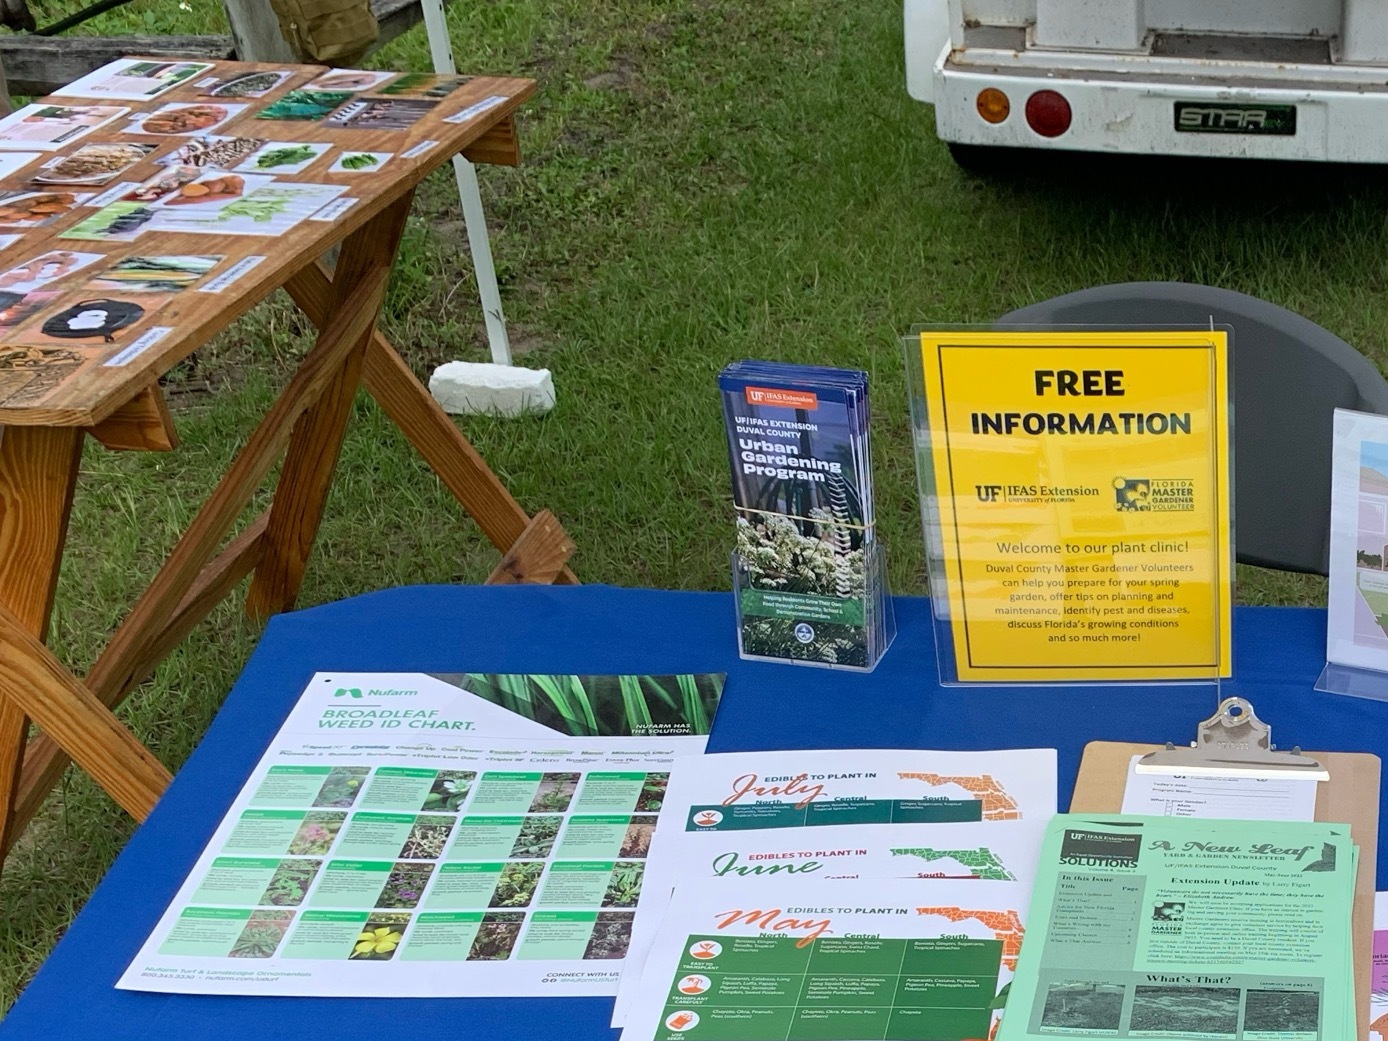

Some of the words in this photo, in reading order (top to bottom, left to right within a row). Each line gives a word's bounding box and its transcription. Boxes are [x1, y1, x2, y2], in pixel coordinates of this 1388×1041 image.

[1179, 108, 1267, 127] STAR
[1035, 370, 1125, 397] FREE
[770, 420, 818, 431] EXTENSION
[971, 413, 1191, 435] INFORMATION
[737, 426, 765, 435] DUVAL
[766, 429, 801, 439] COUNTY
[739, 438, 798, 455] Urban
[741, 451, 842, 473] Gardening
[743, 463, 825, 482] Program
[976, 486, 1002, 503] UF
[1008, 486, 1037, 496] IFAS
[1040, 486, 1099, 496] Extension
[1152, 488, 1194, 497] MASTER
[997, 542, 1062, 554] Welcome
[1066, 543, 1080, 554] to
[1084, 545, 1107, 554] our
[1112, 542, 1146, 556] plant
[1150, 542, 1189, 553] clinic!
[986, 564, 1014, 572] Duval
[1016, 564, 1052, 574] County
[1055, 564, 1089, 573] Master
[1092, 564, 1138, 573] Gardener
[1141, 563, 1193, 572] Volunteers
[1022, 578, 1044, 589] help
[1047, 580, 1064, 588] you
[1068, 580, 1106, 589] prepare
[1108, 578, 1122, 587] for
[1126, 580, 1147, 588] your
[1150, 578, 1180, 588] spring
[1010, 592, 1046, 602] garden,
[1050, 592, 1073, 600] offer
[1076, 592, 1094, 602] tips
[1112, 592, 1153, 602] planning
[1156, 592, 1173, 600] and
[995, 606, 1061, 616] maintenance,
[1064, 606, 1100, 616] identify
[1104, 607, 1124, 616] pest
[1127, 606, 1144, 614] and
[1147, 606, 1190, 615] diseases,
[1008, 620, 1042, 628] discuss
[1044, 620, 1085, 628] Florida's
[1088, 620, 1126, 630] growing
[1130, 620, 1178, 628] conditions
[1048, 634, 1066, 642] and
[1082, 634, 1108, 642] much
[1112, 634, 1140, 642] more!
[322, 710, 439, 718] BROADLEAF
[318, 720, 373, 729] WEED
[381, 720, 401, 728] ID
[408, 720, 476, 731] CHART.
[721, 773, 828, 809] July
[1148, 840, 1175, 851] A
[1182, 841, 1241, 853] New
[1249, 843, 1314, 861] Leaf
[749, 852, 796, 861] EDIBLES
[712, 852, 824, 877] June
[1059, 857, 1138, 868] SOLUTIONS
[1171, 877, 1220, 885] Extension
[714, 908, 834, 949] May
[1146, 975, 1191, 984] What's
[1196, 976, 1231, 984] That?
